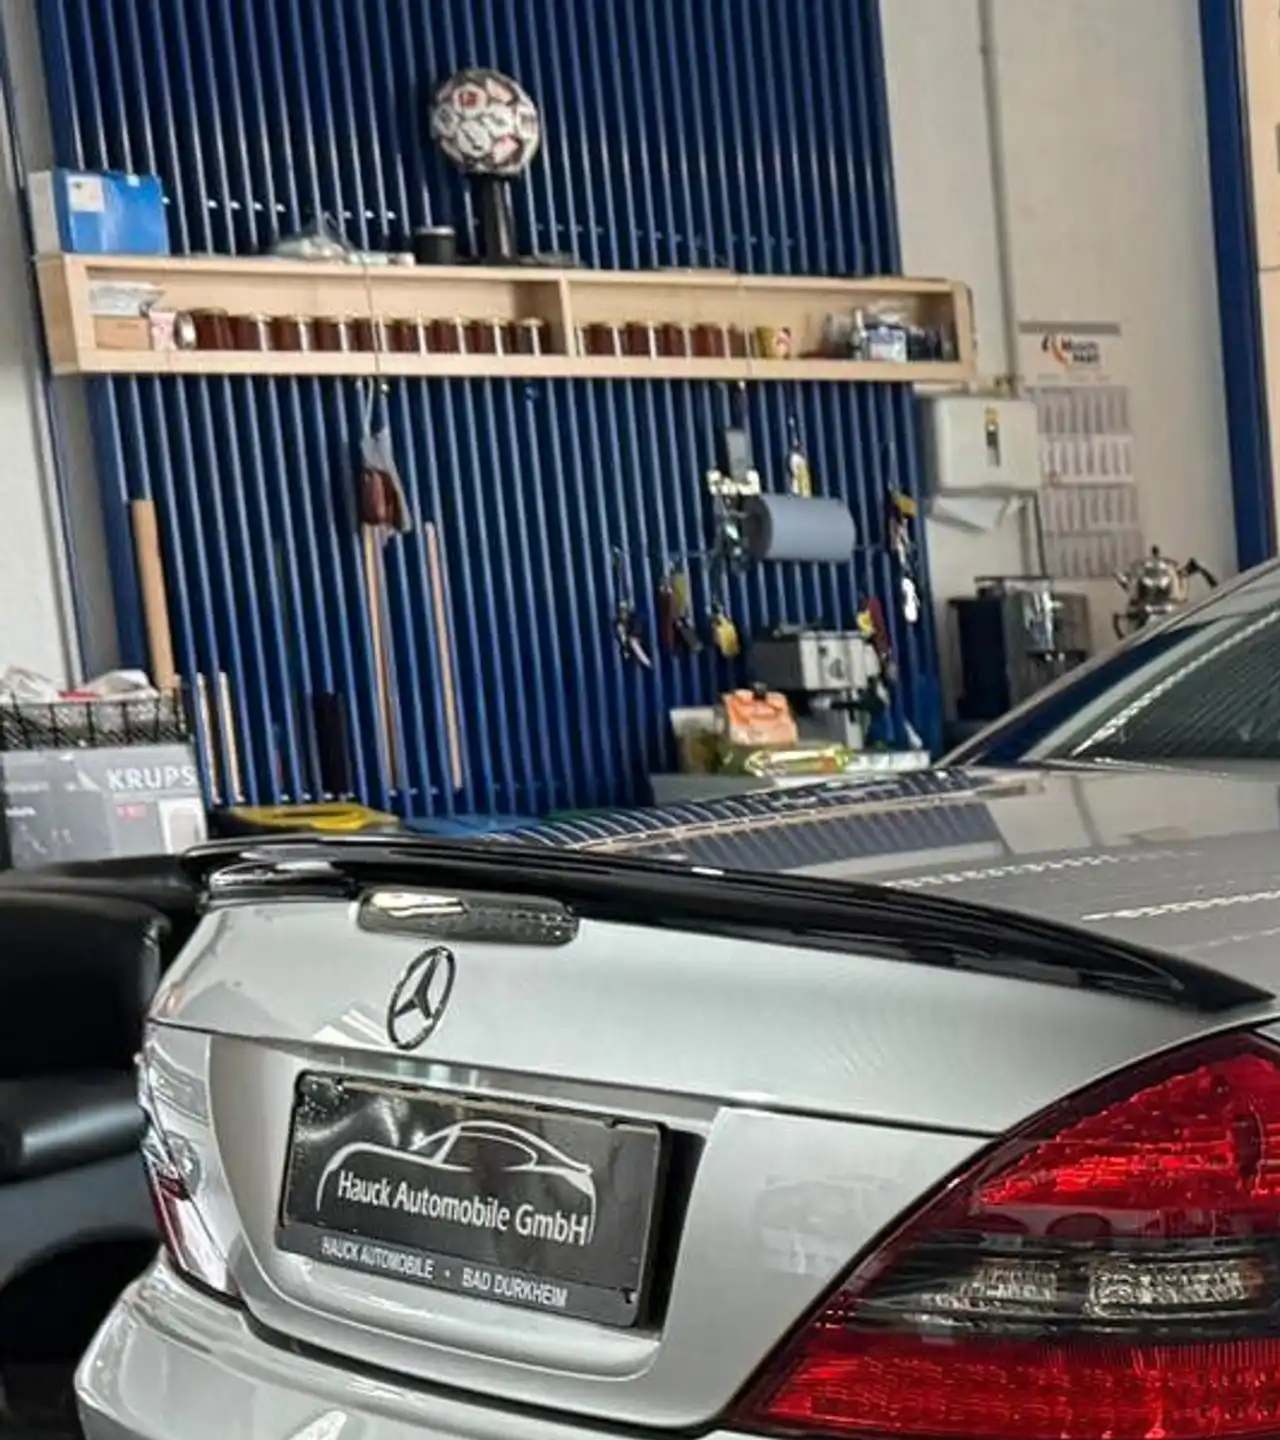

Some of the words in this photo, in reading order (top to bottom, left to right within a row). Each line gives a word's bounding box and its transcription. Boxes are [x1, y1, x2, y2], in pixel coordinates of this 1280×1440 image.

[105, 765, 196, 791] KRUPS
[337, 1170, 390, 1208] Hauck
[392, 1181, 510, 1231] Automobile
[515, 1204, 590, 1247] GmbH
[320, 1235, 359, 1262] HAUCK
[360, 1244, 435, 1280] AUTOMOBILE
[462, 1267, 492, 1291] BAD
